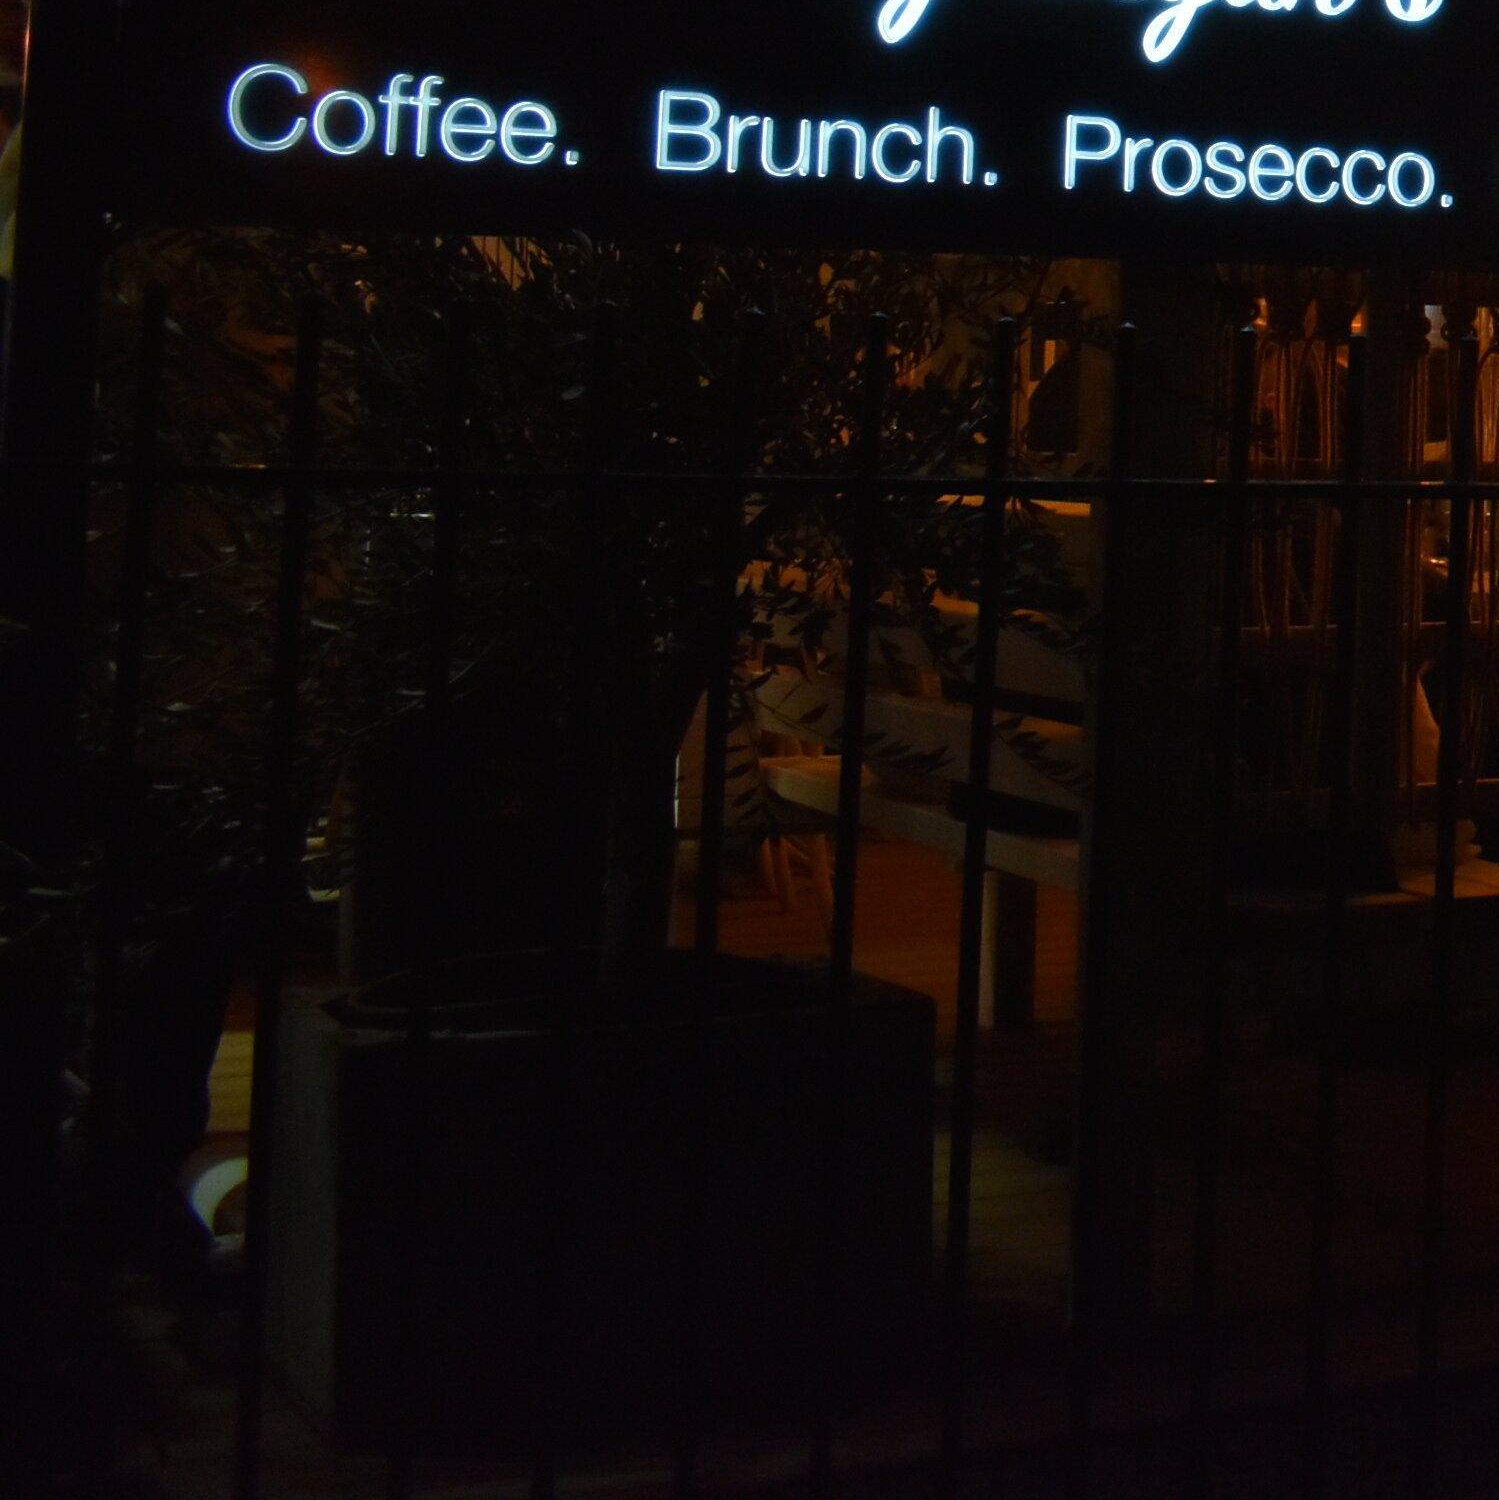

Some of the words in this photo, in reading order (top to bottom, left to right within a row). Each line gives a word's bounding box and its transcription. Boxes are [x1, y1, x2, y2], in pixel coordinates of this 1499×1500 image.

[229, 63, 579, 166] Coffee.
[656, 89, 996, 186] Brunch.
[1064, 114, 1452, 208] Prosecco.
